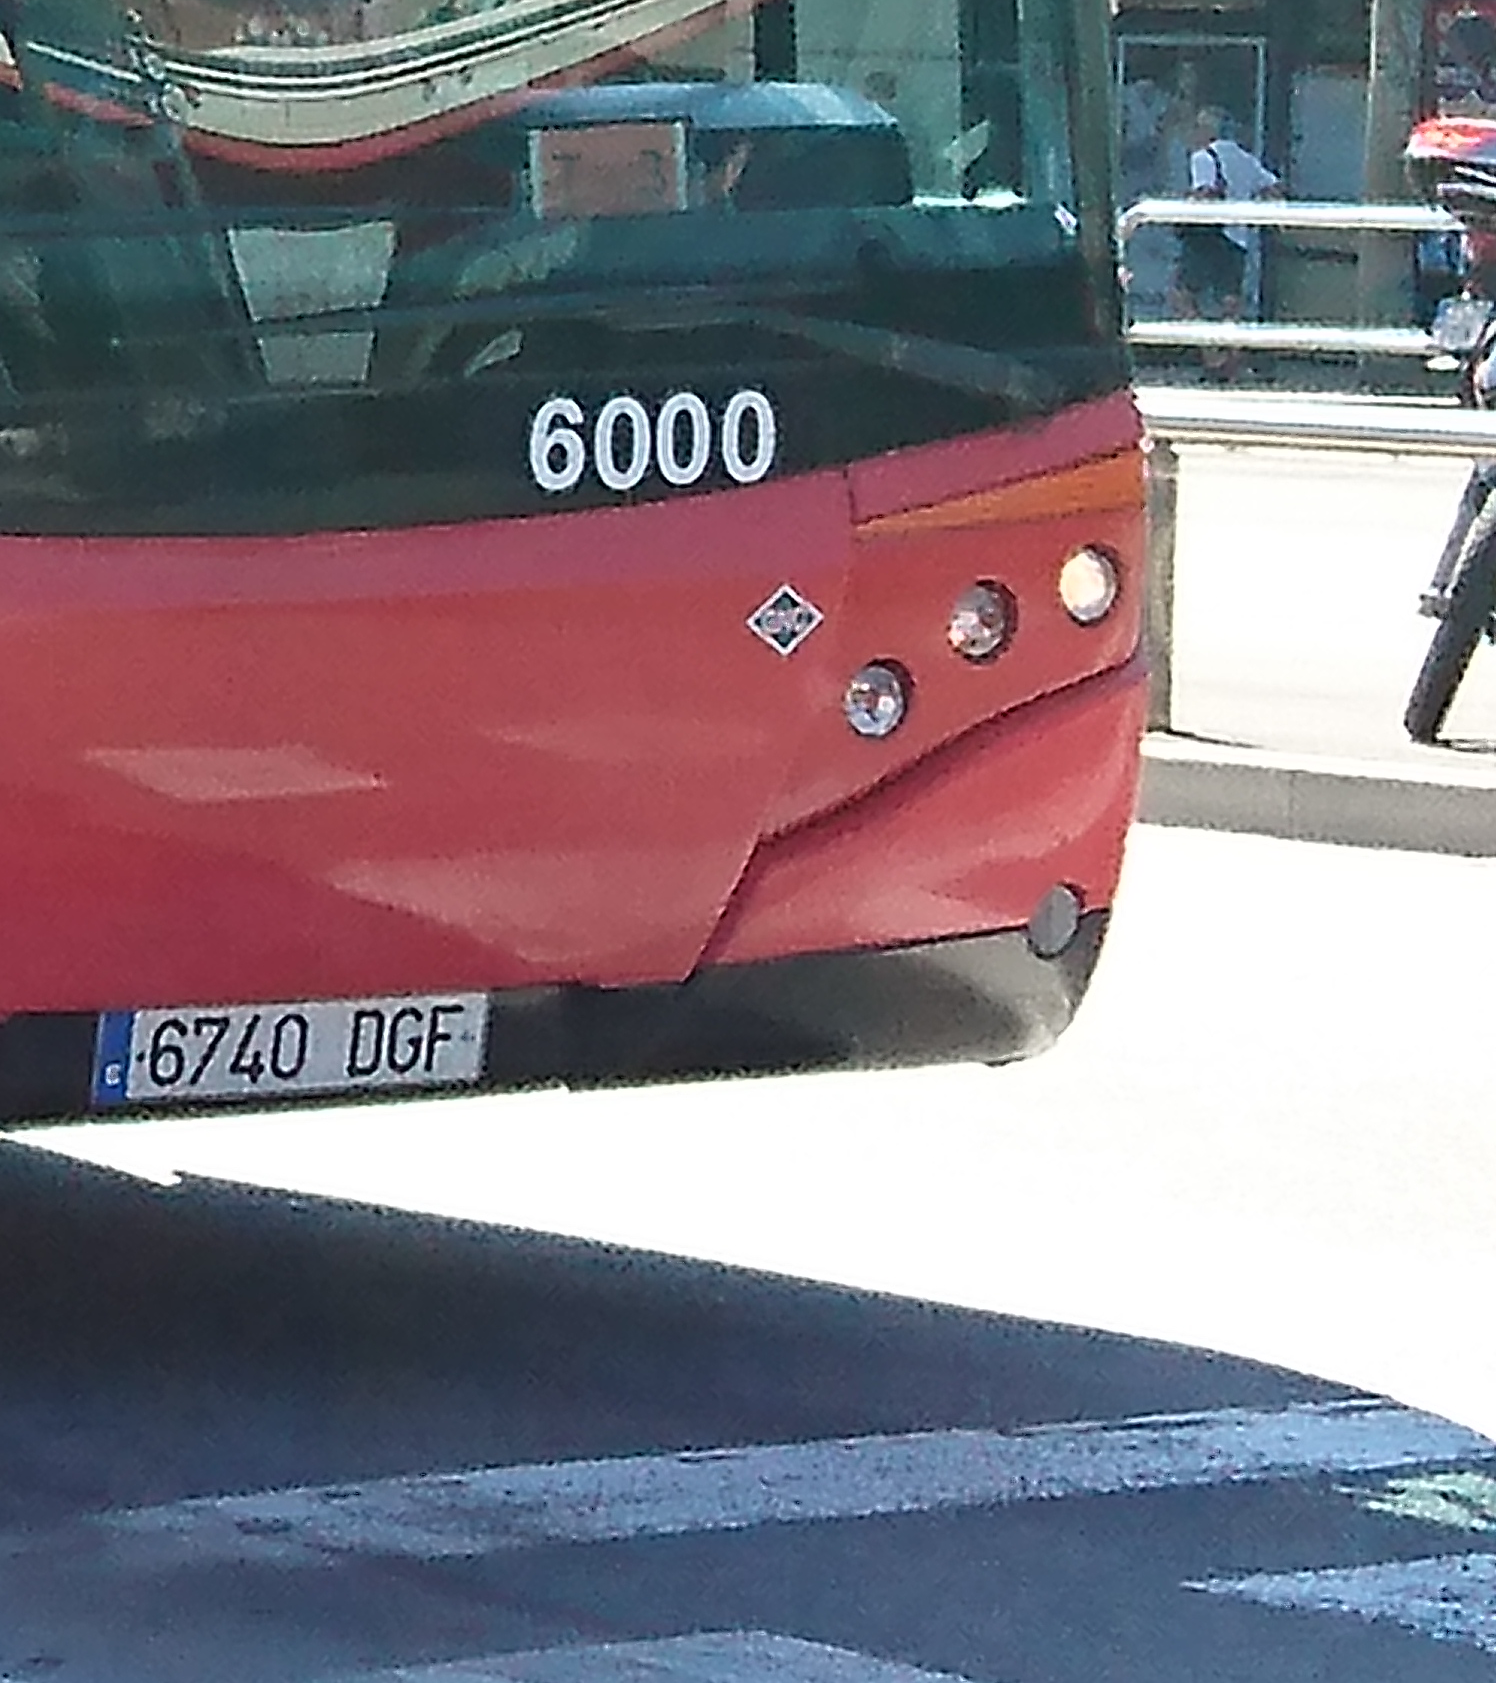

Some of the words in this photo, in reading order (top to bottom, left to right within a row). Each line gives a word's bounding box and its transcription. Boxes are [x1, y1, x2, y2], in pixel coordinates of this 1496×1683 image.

[528, 390, 777, 492] 6000
[148, 1013, 309, 1087] 6740
[347, 1003, 465, 1078] DGF
